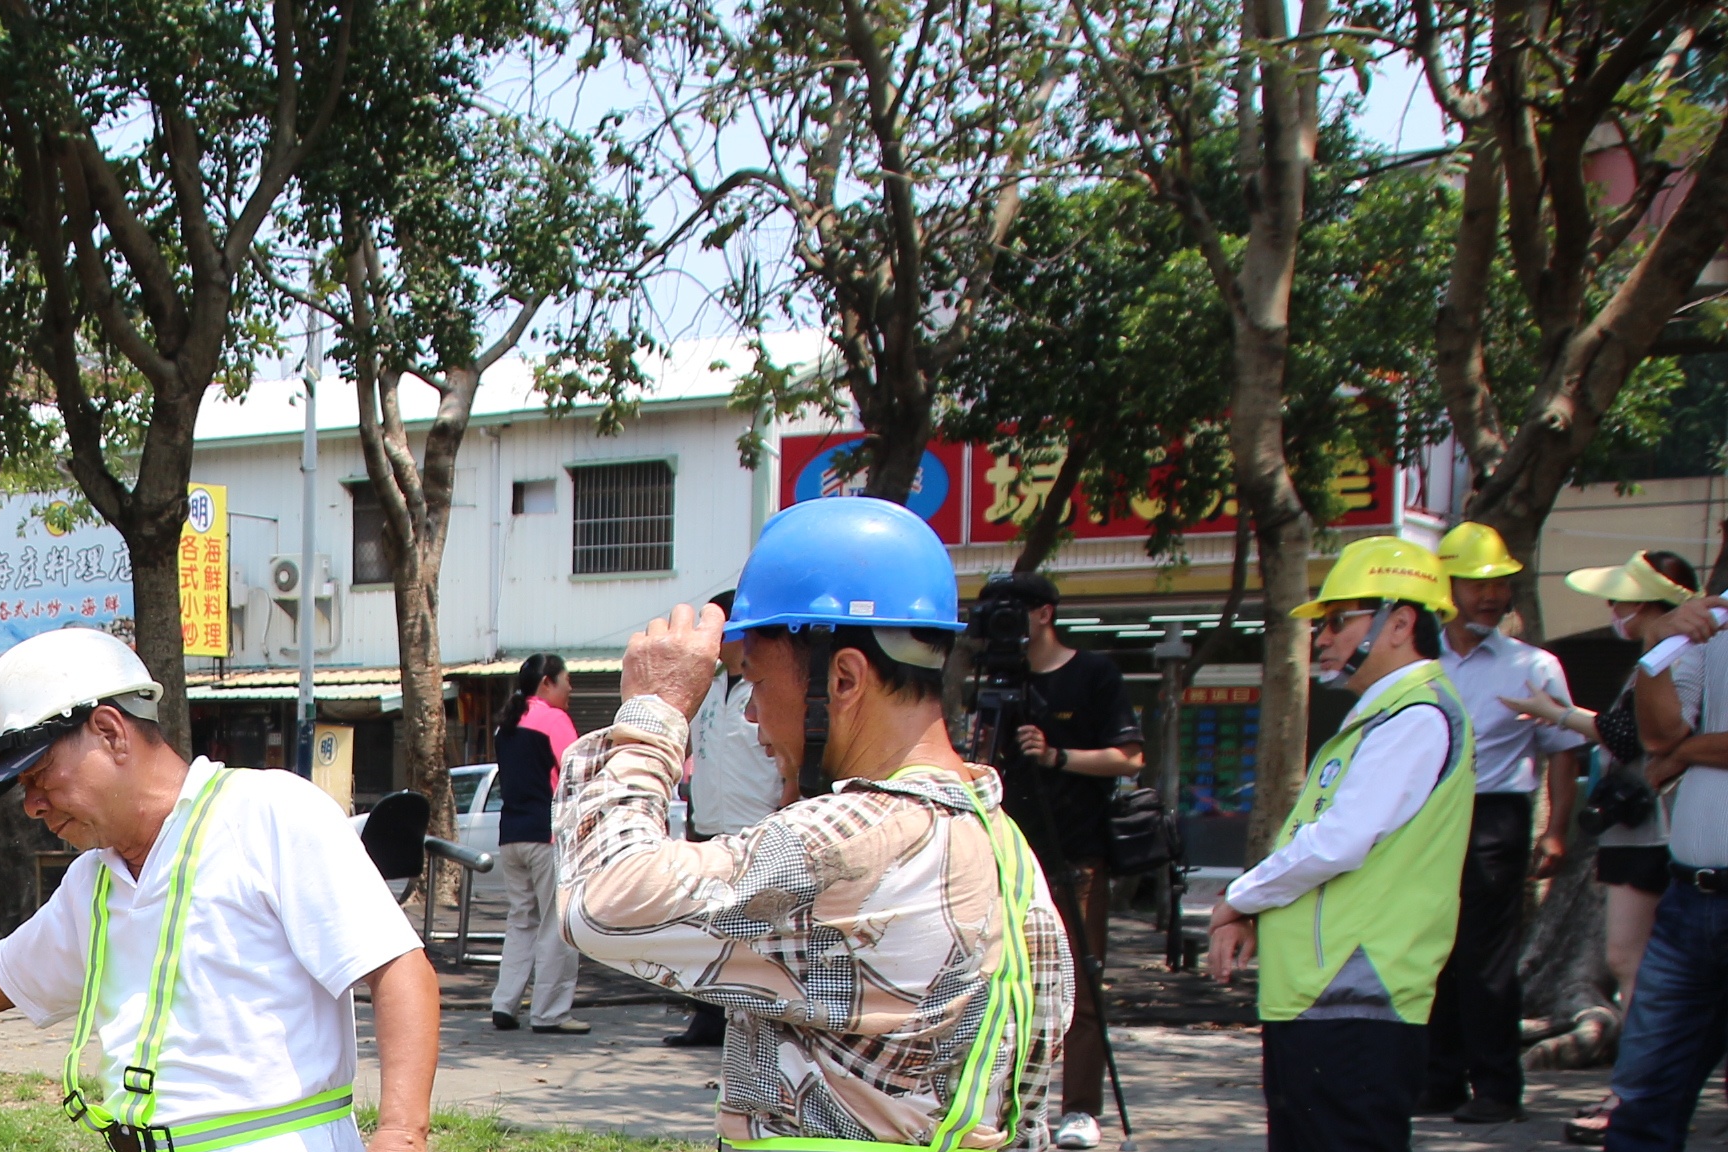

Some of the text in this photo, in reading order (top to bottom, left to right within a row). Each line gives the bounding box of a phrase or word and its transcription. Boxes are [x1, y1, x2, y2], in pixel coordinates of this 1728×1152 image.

[191, 495, 208, 528] 明
[180, 535, 199, 648] 各式小炒
[203, 535, 222, 648] 海鮮料理
[321, 737, 333, 760] 明
